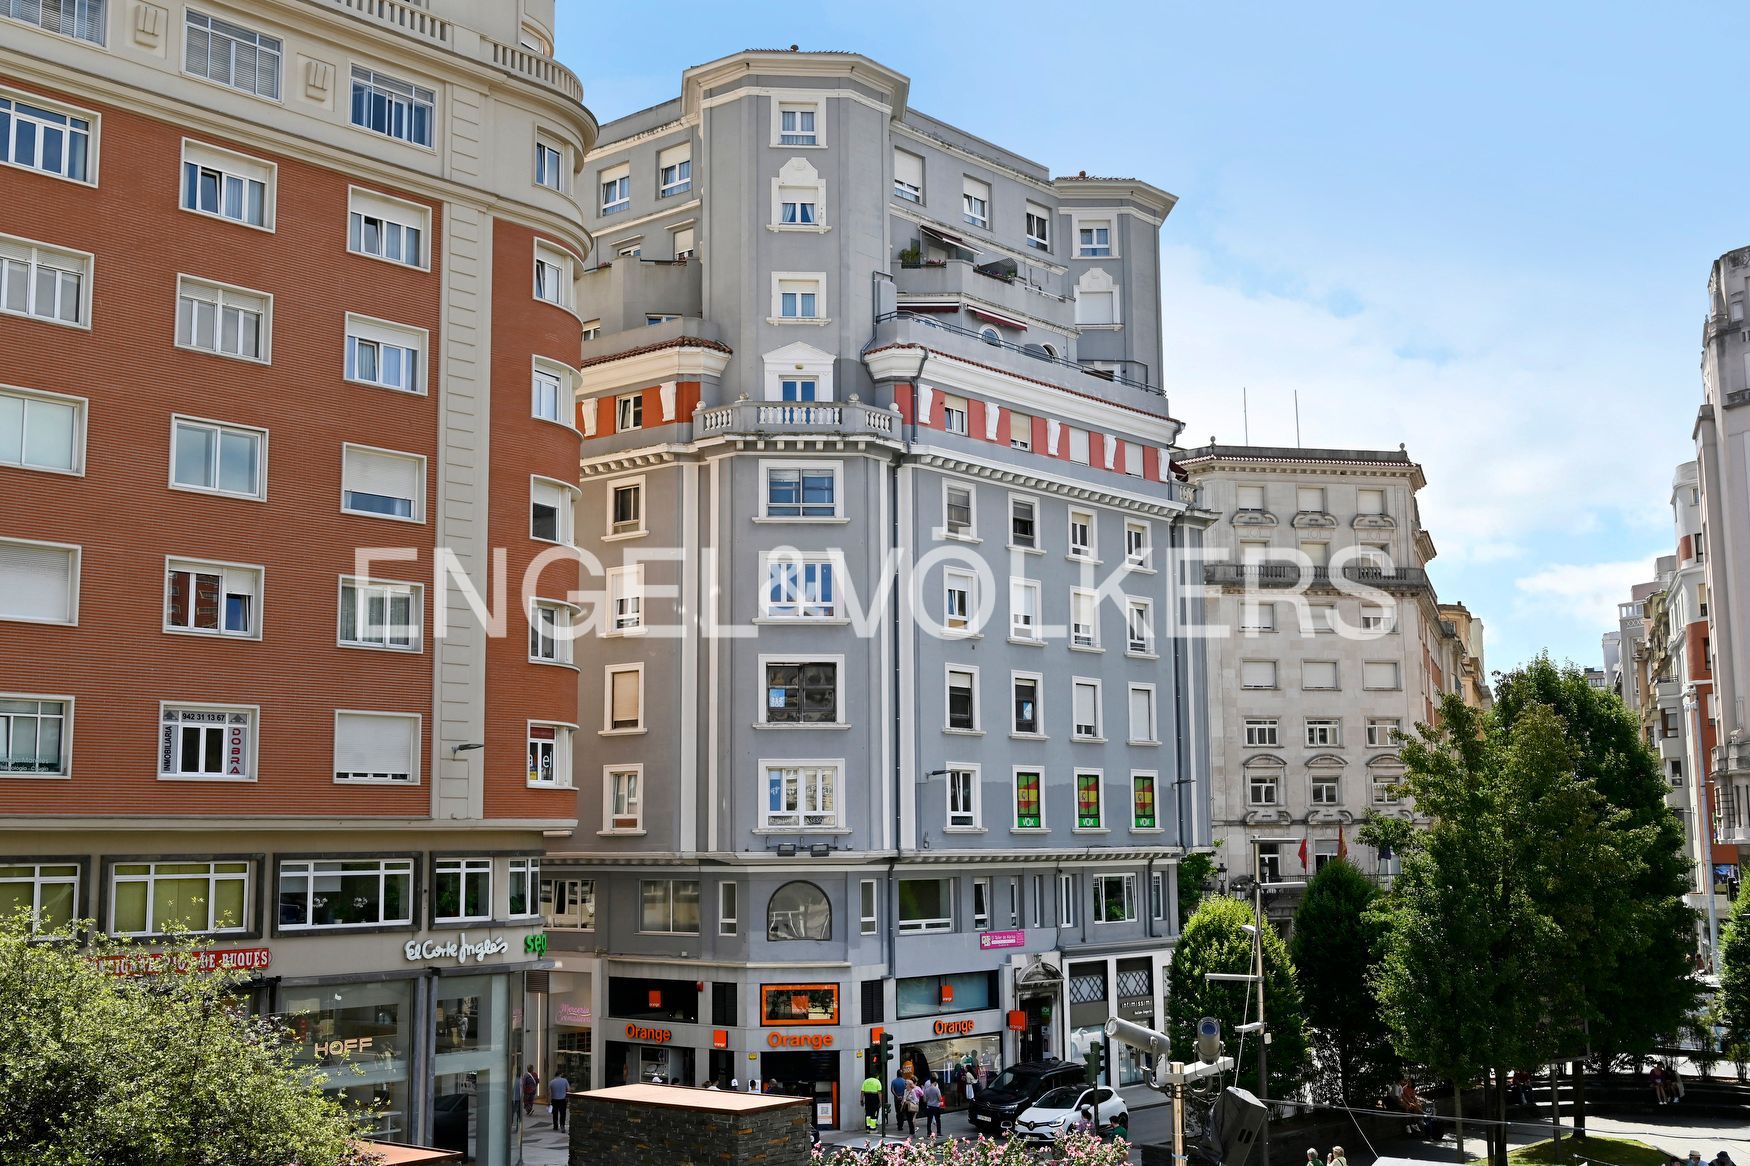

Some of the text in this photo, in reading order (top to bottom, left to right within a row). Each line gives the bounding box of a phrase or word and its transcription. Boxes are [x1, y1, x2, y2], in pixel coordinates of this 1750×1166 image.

[163, 726, 172, 771] INMOBILIARIA
[230, 728, 241, 774] DOBRA
[1022, 817, 1035, 827] VOX
[1082, 817, 1094, 827] VOX
[1139, 817, 1150, 827] VOX
[404, 932, 509, 964] El Corte Inglés
[625, 1023, 672, 1044] Orange
[934, 1019, 975, 1036] Orange
[314, 1037, 373, 1056] HOFF
[767, 1031, 834, 1050] Orange
